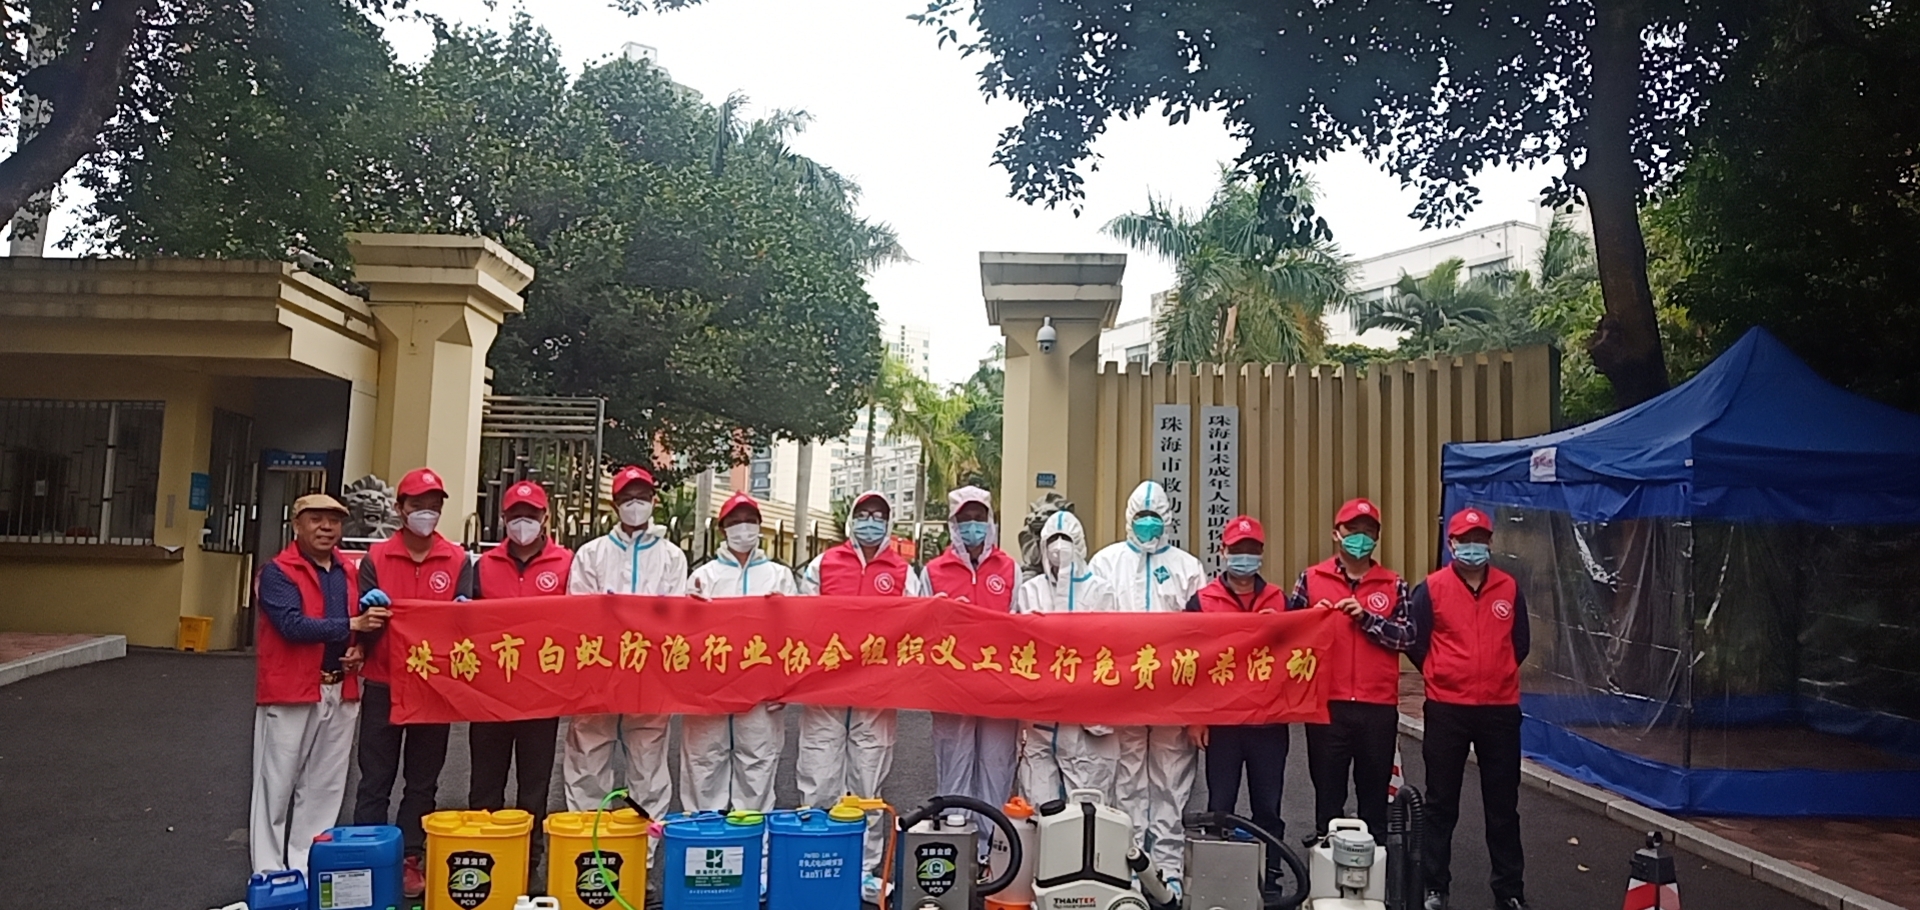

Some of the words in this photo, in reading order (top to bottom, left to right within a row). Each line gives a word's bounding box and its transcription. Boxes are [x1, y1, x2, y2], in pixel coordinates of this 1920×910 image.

[406, 631, 1317, 690] 珠海市白蚁防治行业协会组织义工进行免费消杀活动
[1053, 897, 1097, 905] THANTEK
